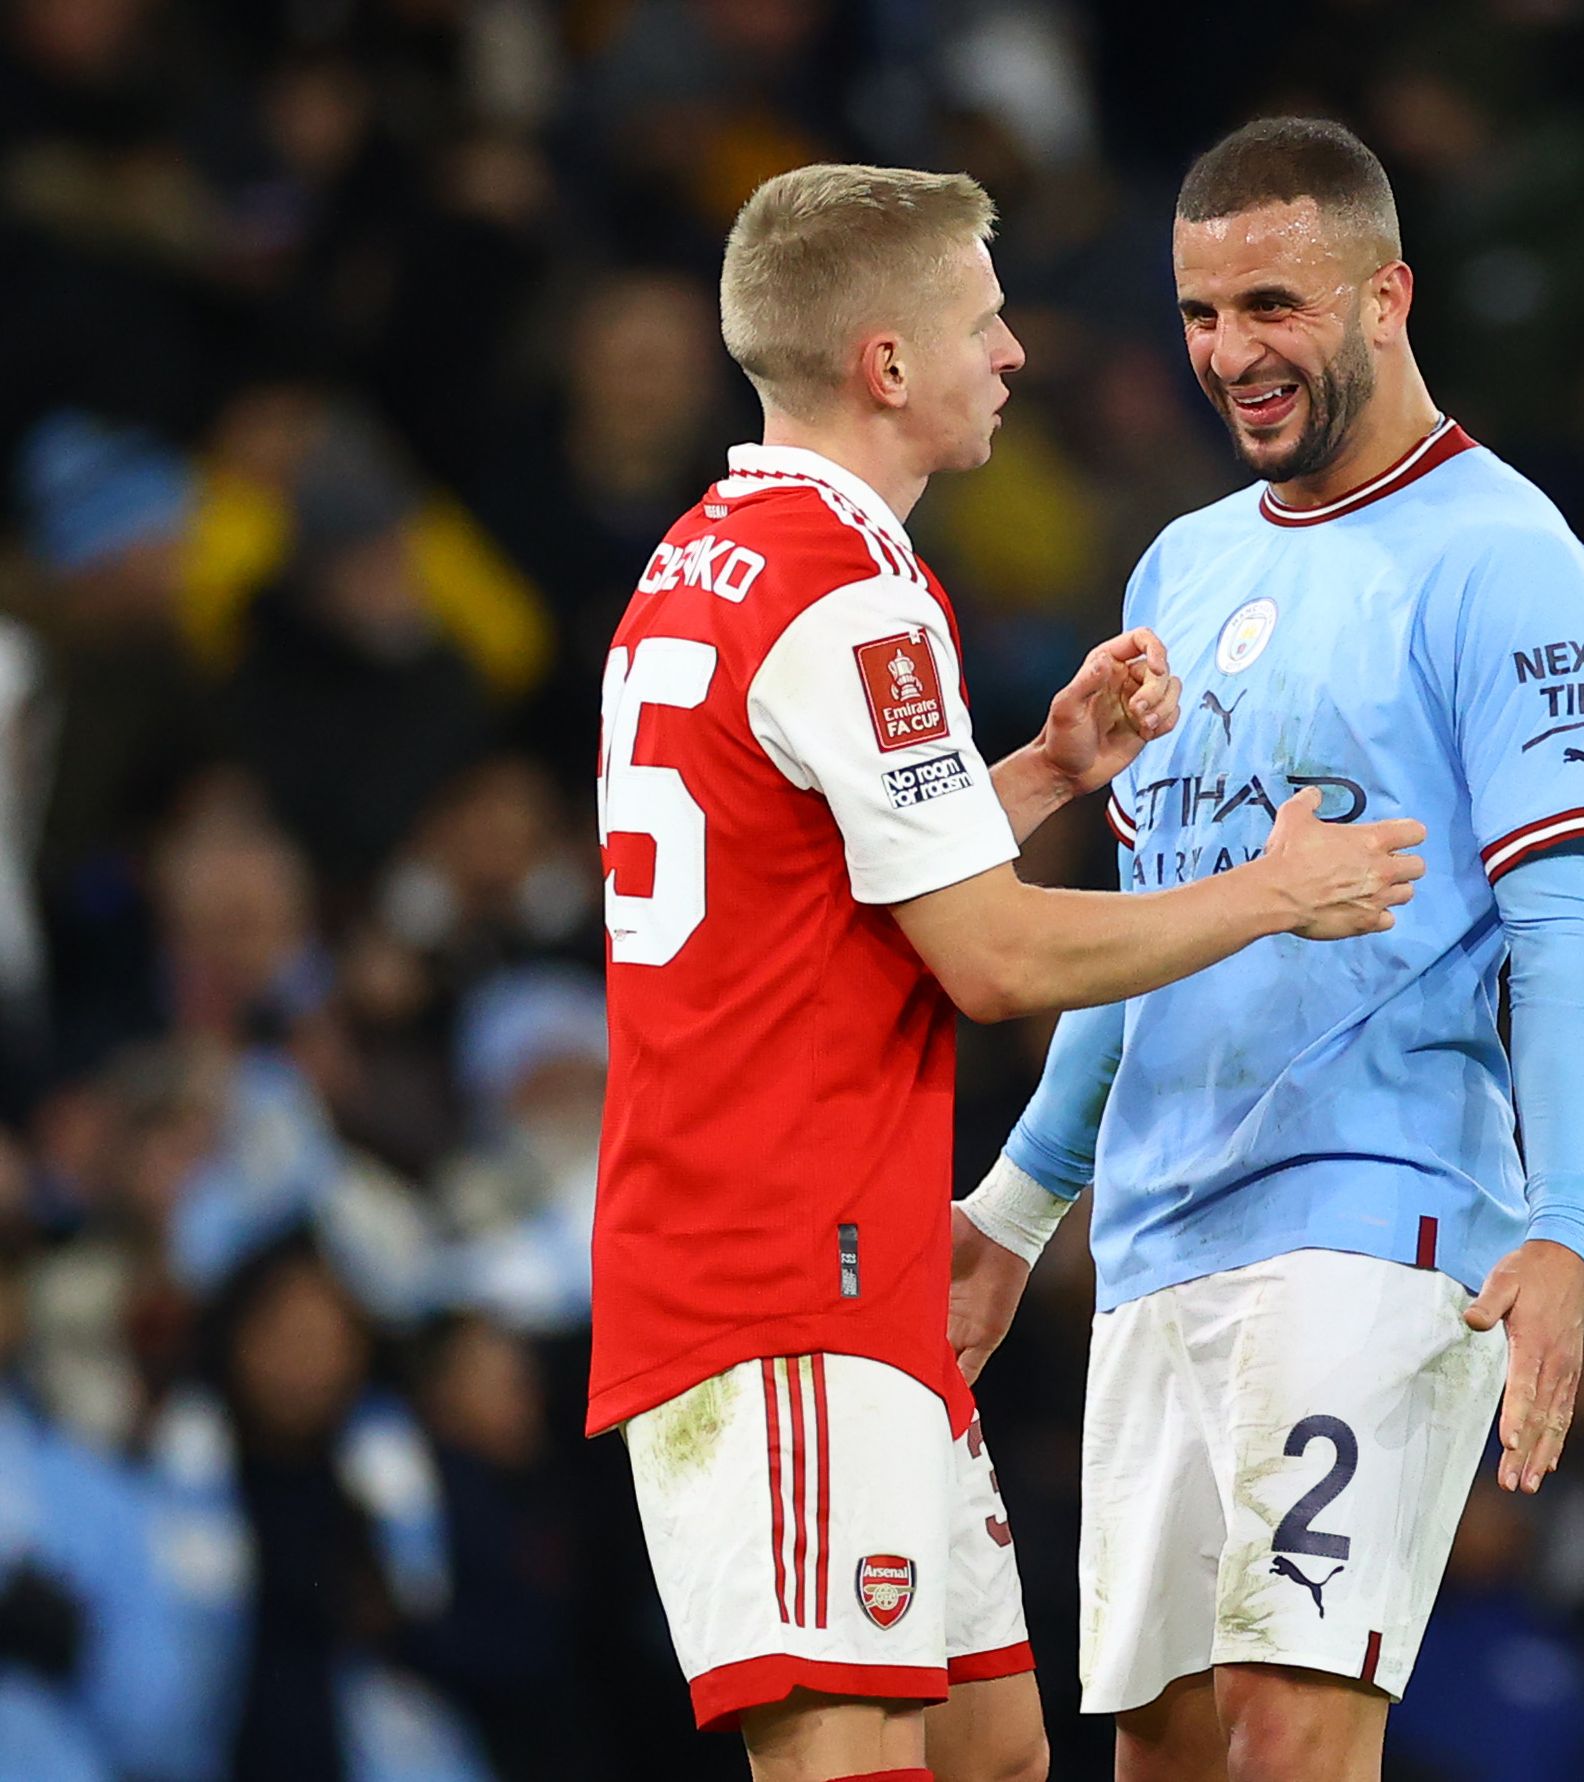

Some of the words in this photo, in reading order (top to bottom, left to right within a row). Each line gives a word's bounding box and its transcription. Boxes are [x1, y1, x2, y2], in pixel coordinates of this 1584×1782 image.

[883, 699, 937, 722] Emirates
[887, 719, 911, 738] FA
[912, 711, 940, 731] CUP
[882, 770, 916, 792] No
[916, 757, 961, 786] room
[889, 788, 919, 809] for
[920, 772, 972, 800] racism
[1271, 1415, 1358, 1560] 2
[863, 1564, 908, 1579] Arsenal
